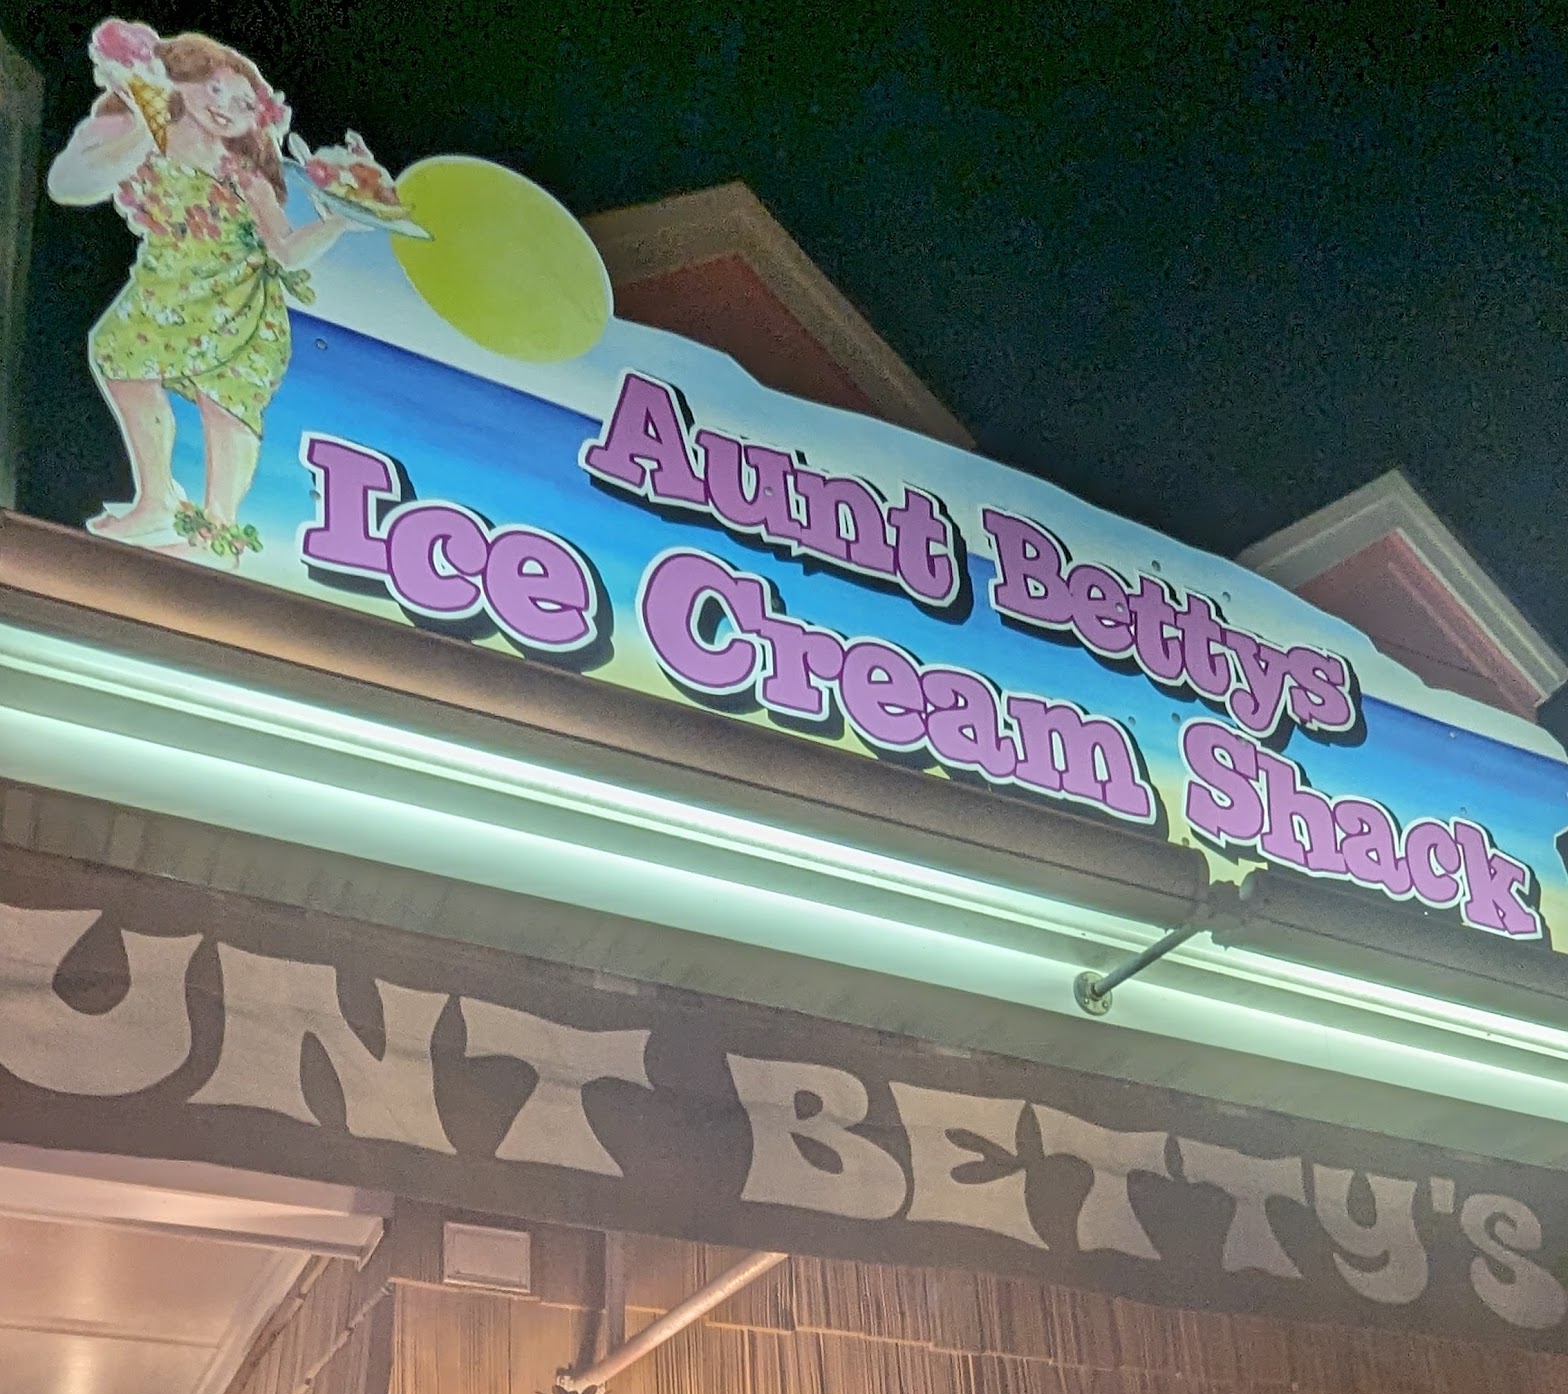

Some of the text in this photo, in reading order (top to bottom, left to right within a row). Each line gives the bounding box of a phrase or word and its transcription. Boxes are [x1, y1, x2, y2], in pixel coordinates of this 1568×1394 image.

[300, 432, 1544, 940] Ice Cream Shack
[581, 370, 1357, 738] Aunt Bettys
